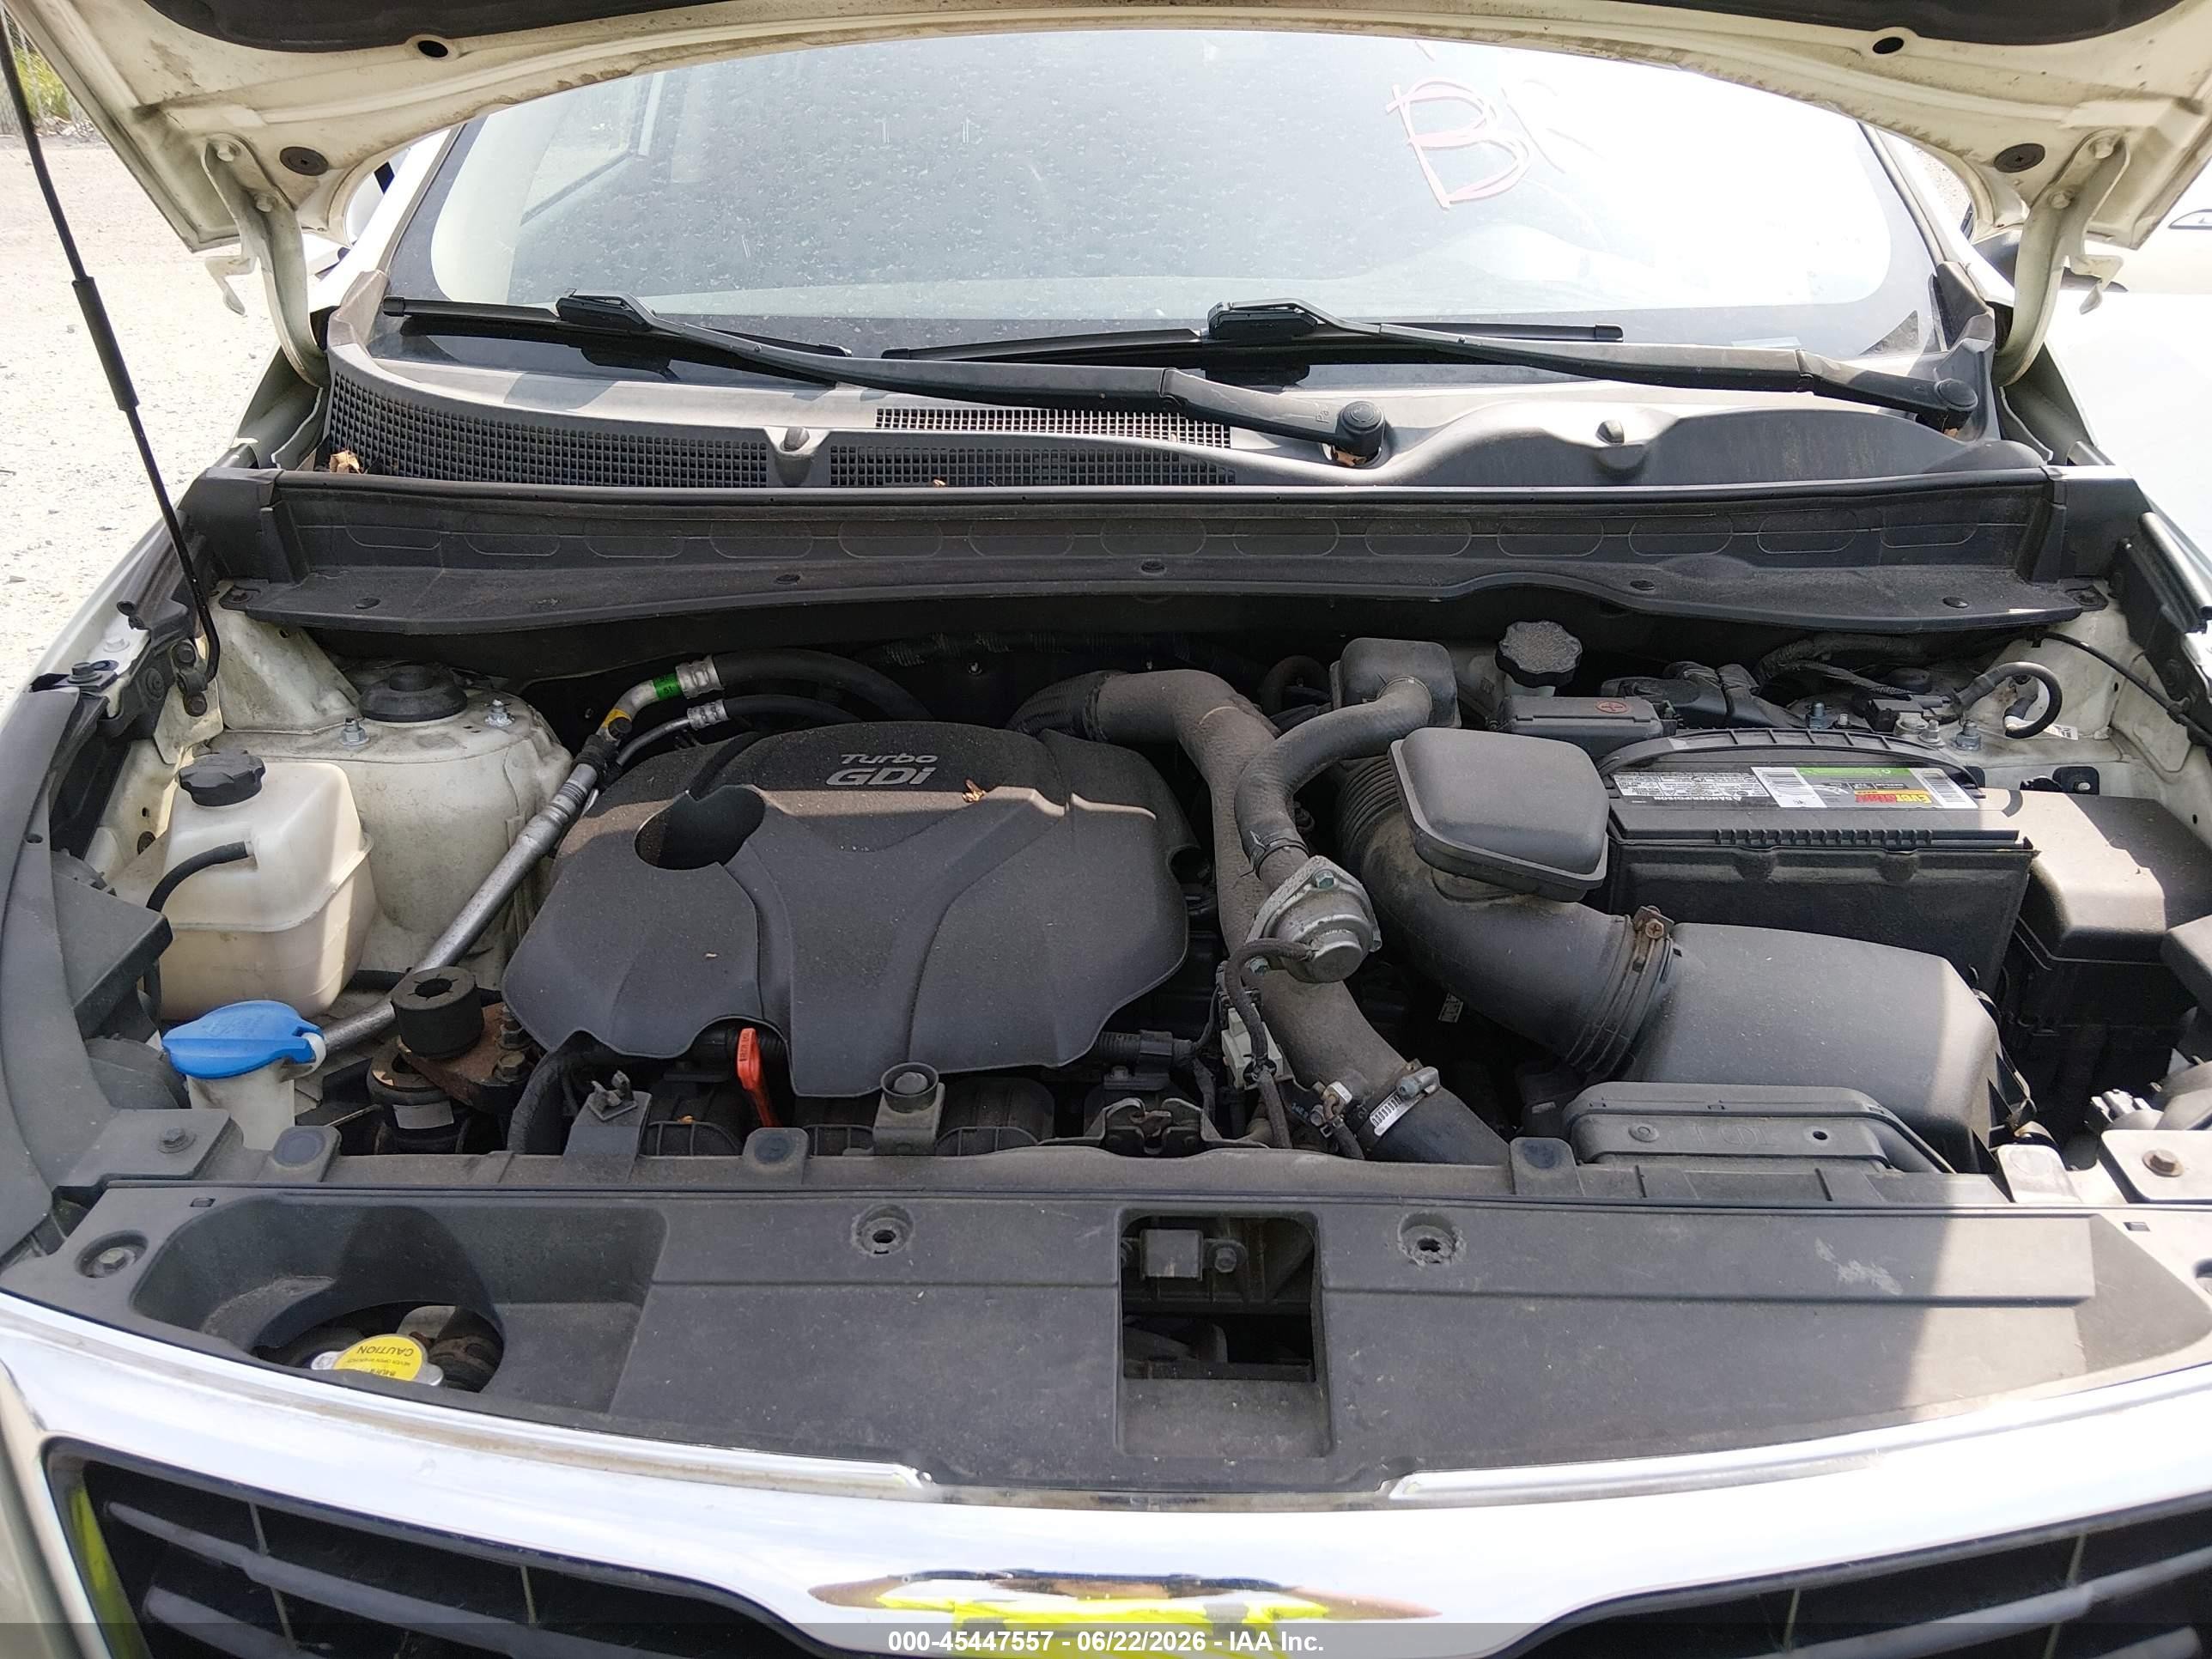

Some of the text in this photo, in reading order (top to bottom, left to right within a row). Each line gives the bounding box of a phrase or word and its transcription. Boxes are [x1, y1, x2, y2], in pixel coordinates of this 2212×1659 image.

[840, 752, 939, 764] Turbo
[825, 767, 937, 786] GDi
[357, 1346, 414, 1357] CAUTION
